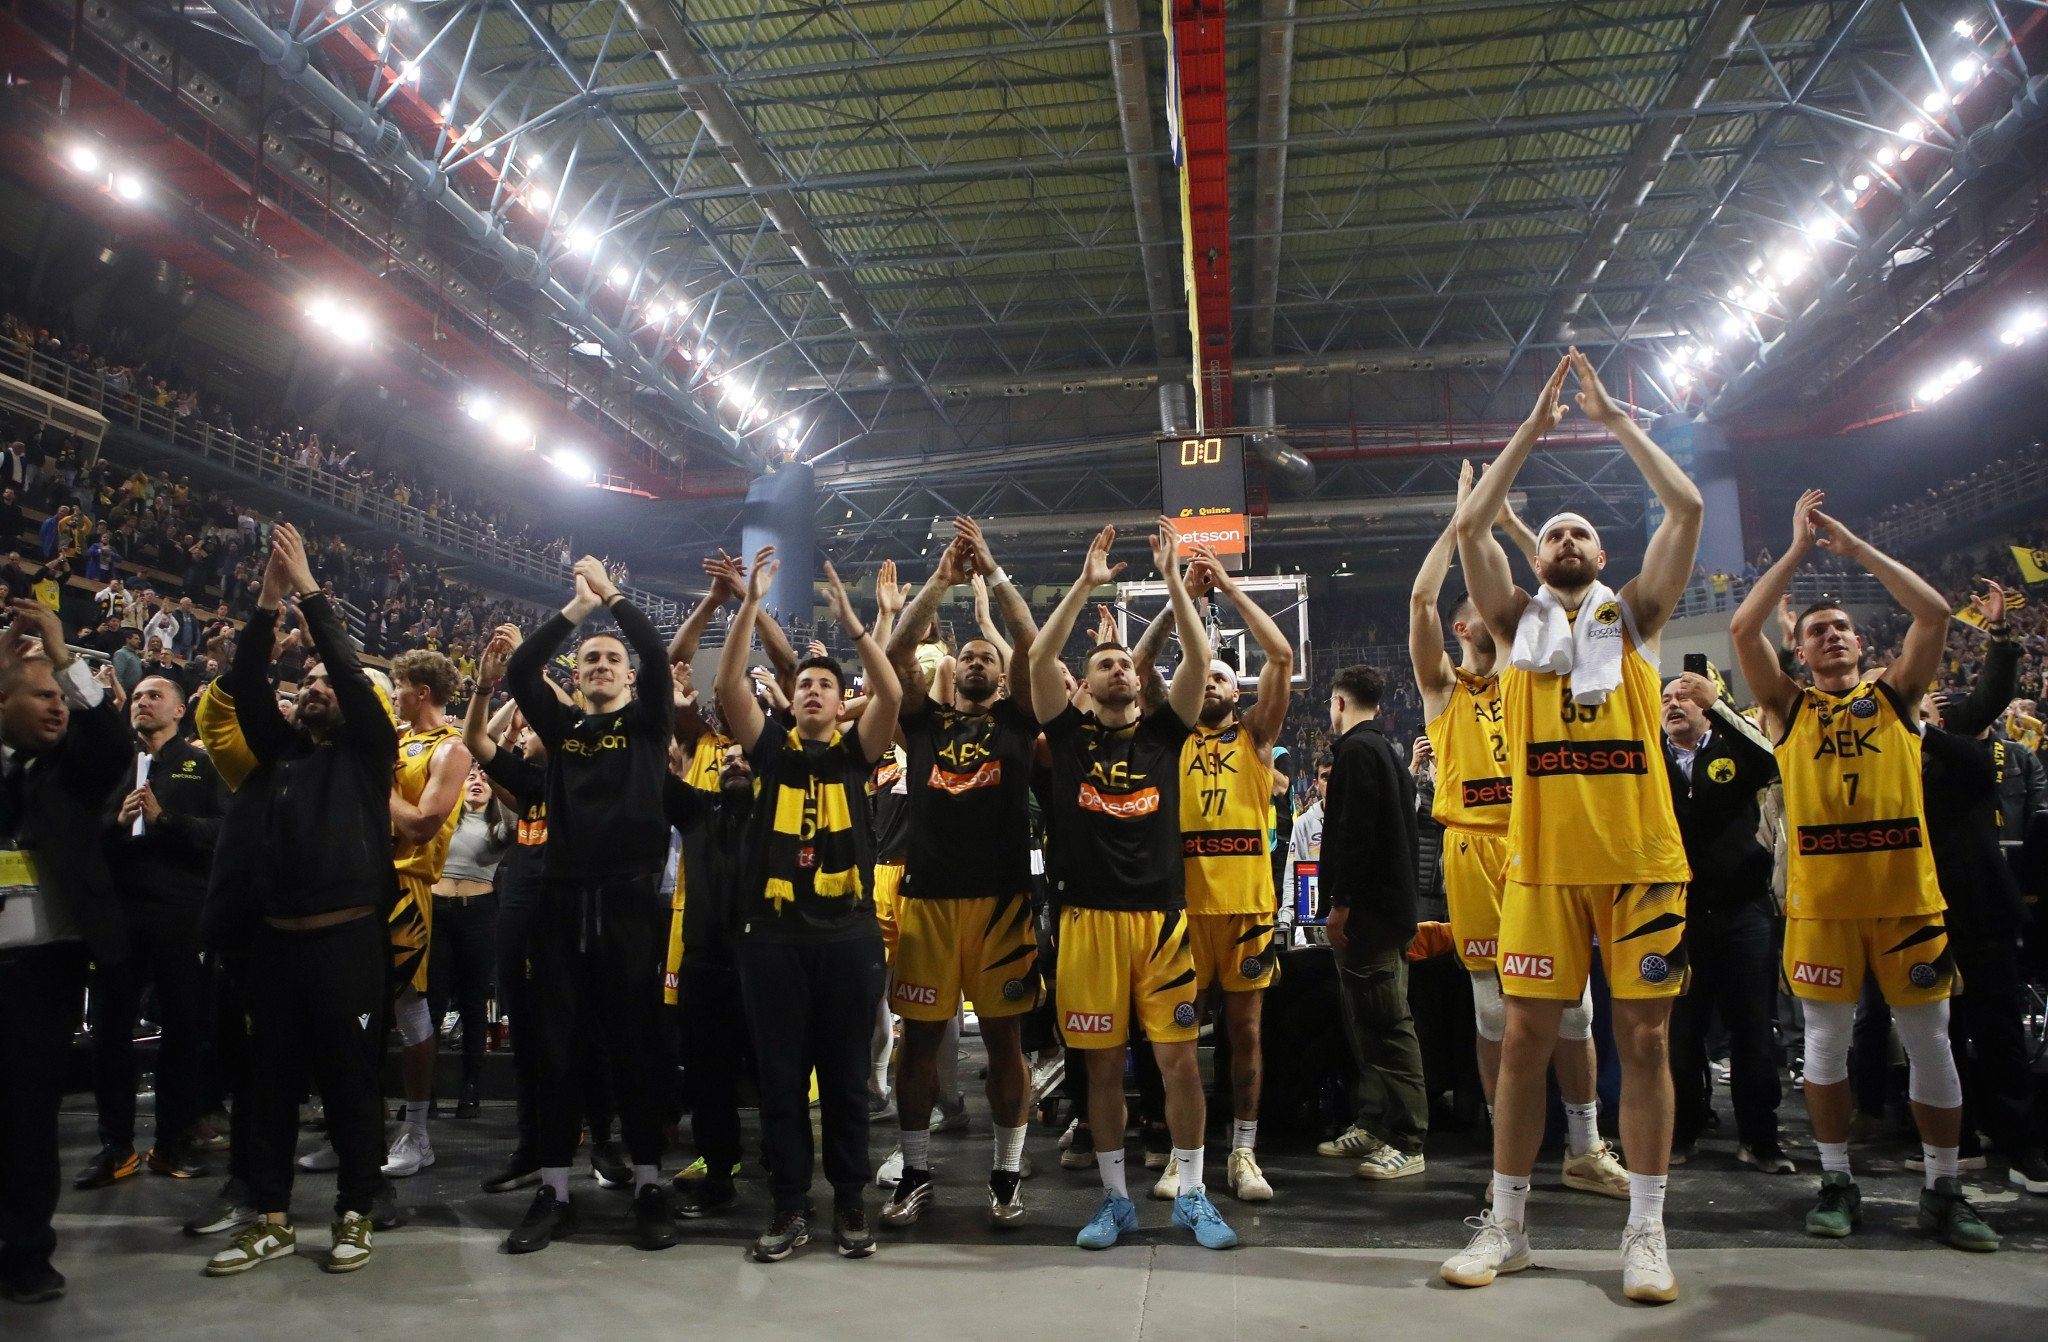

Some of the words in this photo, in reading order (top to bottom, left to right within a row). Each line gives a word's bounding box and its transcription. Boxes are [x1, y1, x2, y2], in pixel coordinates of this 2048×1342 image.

[1181, 438, 1221, 465] 0:0
[1198, 507, 1231, 516] Quince
[1490, 734, 1510, 762] 2
[1813, 727, 1882, 760] AEK
[1527, 747, 1647, 771] betsson
[1087, 761, 1147, 789] AE
[1843, 773, 1859, 806] 7
[1200, 789, 1227, 817] 77
[1184, 835, 1262, 853] etsson
[1800, 826, 1922, 851] betsson
[1465, 940, 1500, 956] AVI
[1503, 955, 1553, 977] AVIS
[1794, 964, 1843, 986] AVIS
[897, 983, 936, 1004] AVIS
[1066, 1013, 1112, 1032] AVIS
